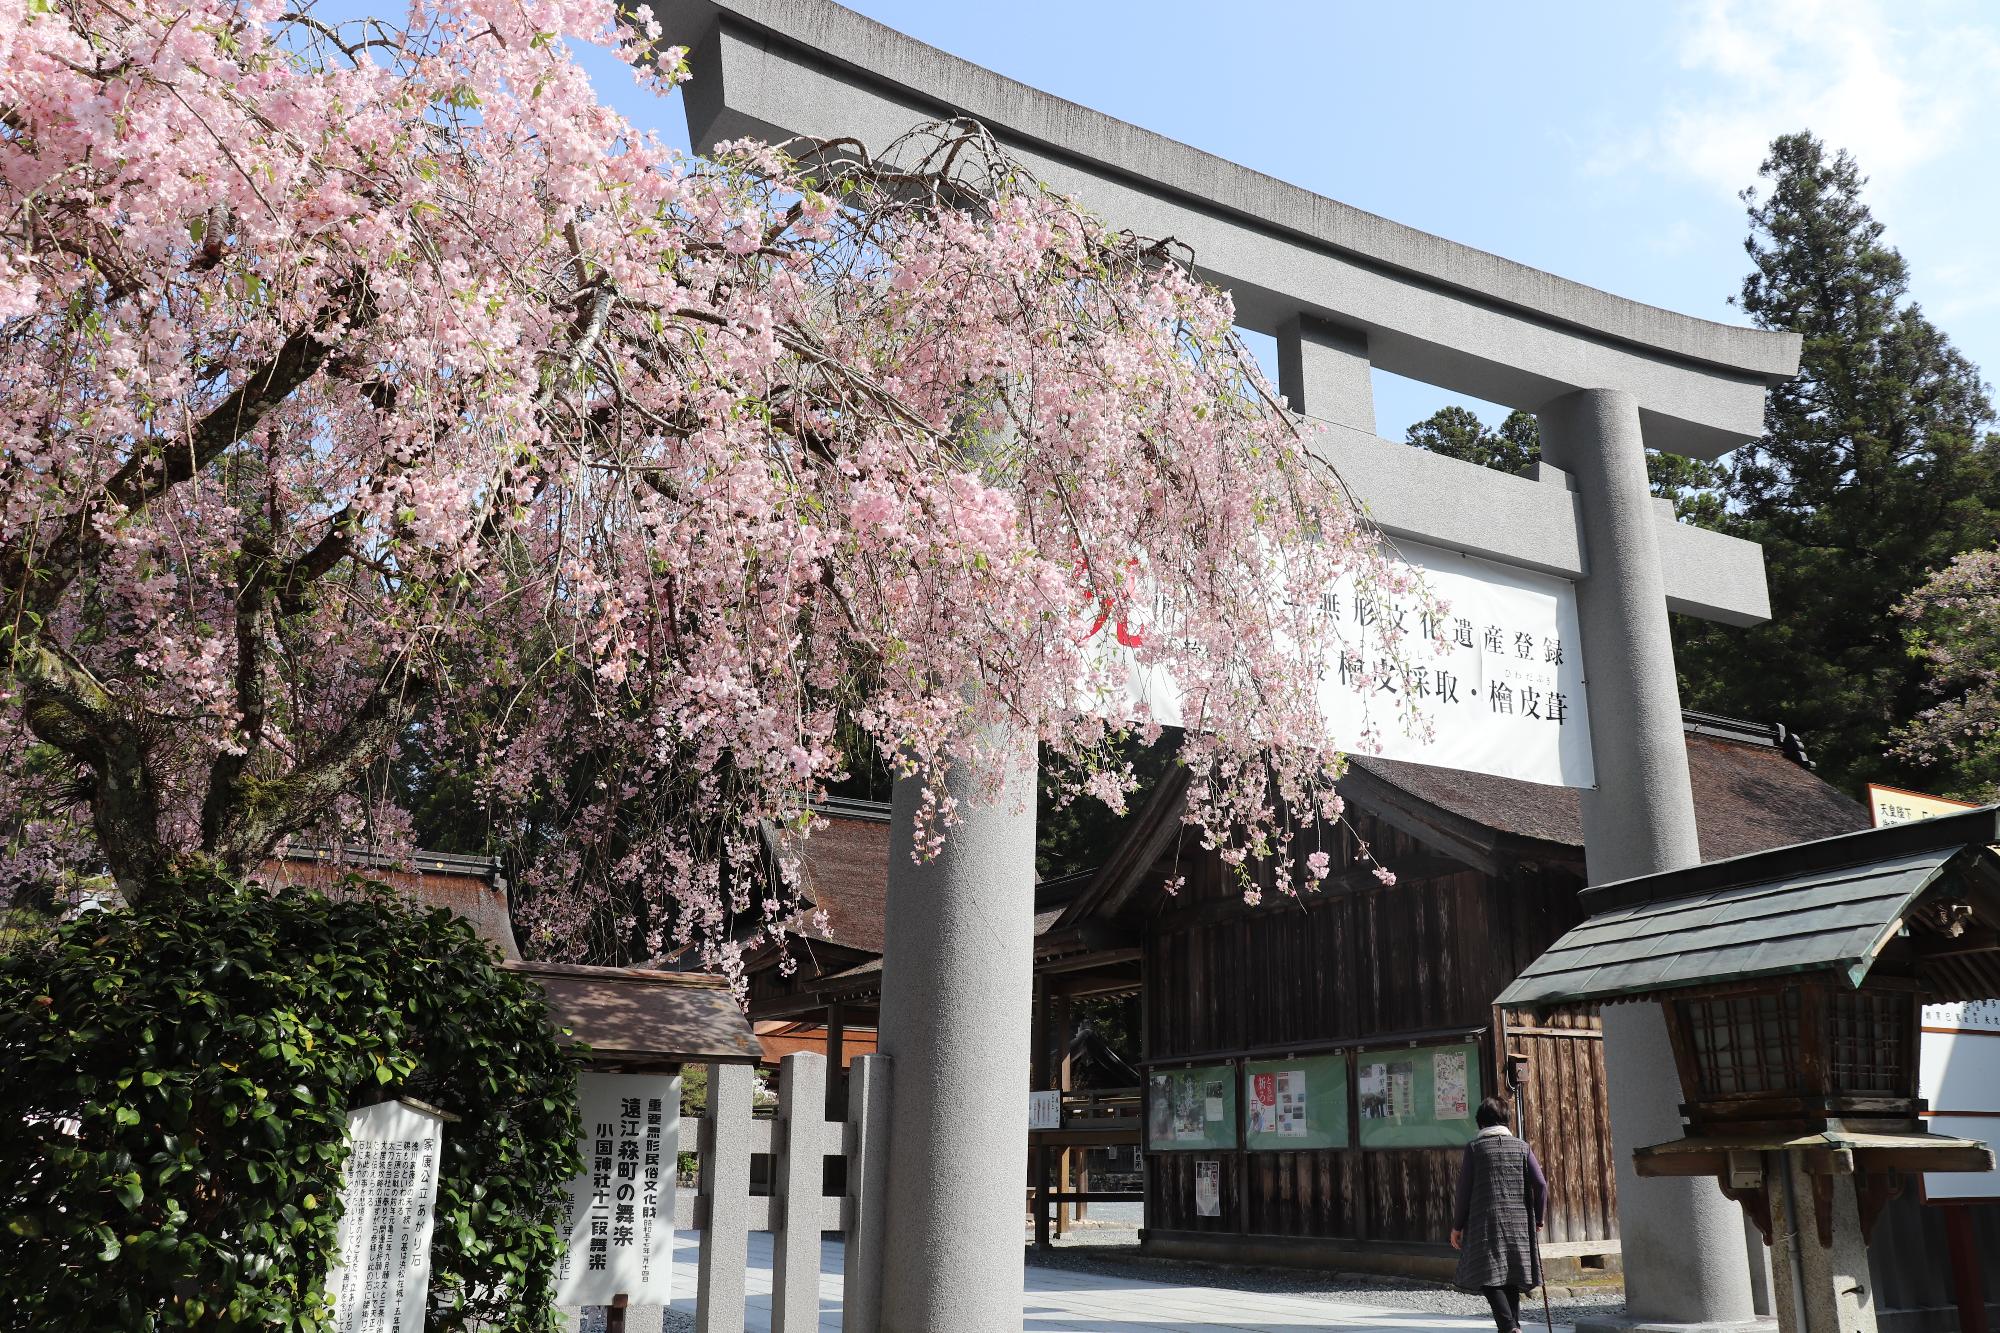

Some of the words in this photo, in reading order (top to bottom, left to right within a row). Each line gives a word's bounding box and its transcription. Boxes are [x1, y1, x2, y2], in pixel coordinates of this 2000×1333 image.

[411, 1138, 434, 1268] 家康公立あがり石
[588, 1122, 614, 1271] 小国神社十二段舞楽
[612, 1098, 641, 1247] 遠江森町の舞楽
[642, 1098, 662, 1219] 重要無形民俗文化財
